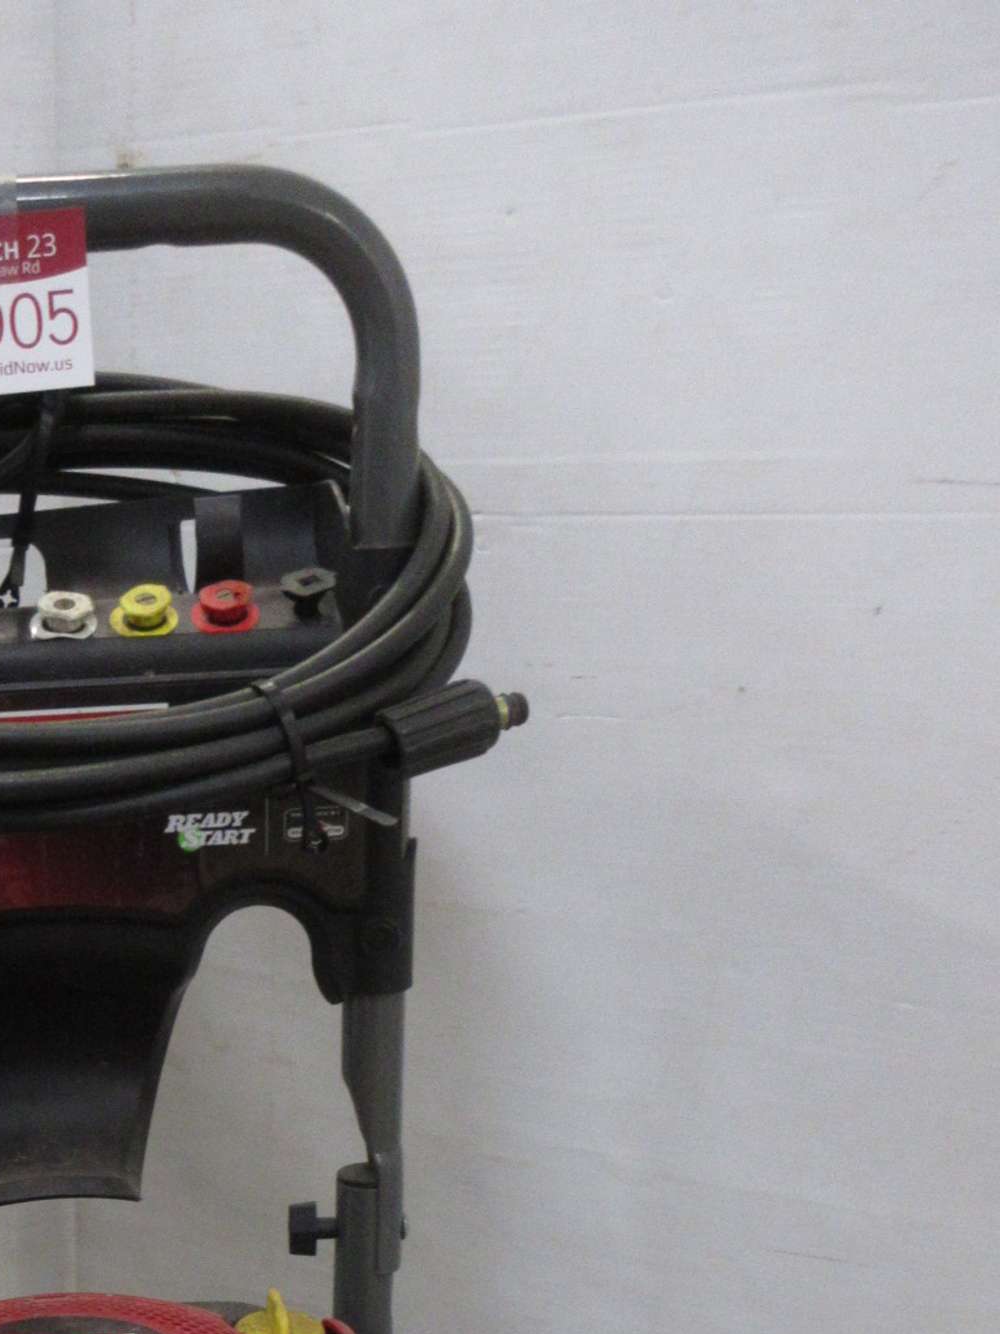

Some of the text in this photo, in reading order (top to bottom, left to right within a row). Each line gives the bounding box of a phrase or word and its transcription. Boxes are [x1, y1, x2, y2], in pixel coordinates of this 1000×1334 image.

[26, 233, 57, 259] 23
[22, 260, 41, 275] Rd
[164, 810, 250, 833] READY
[178, 828, 256, 851] START
